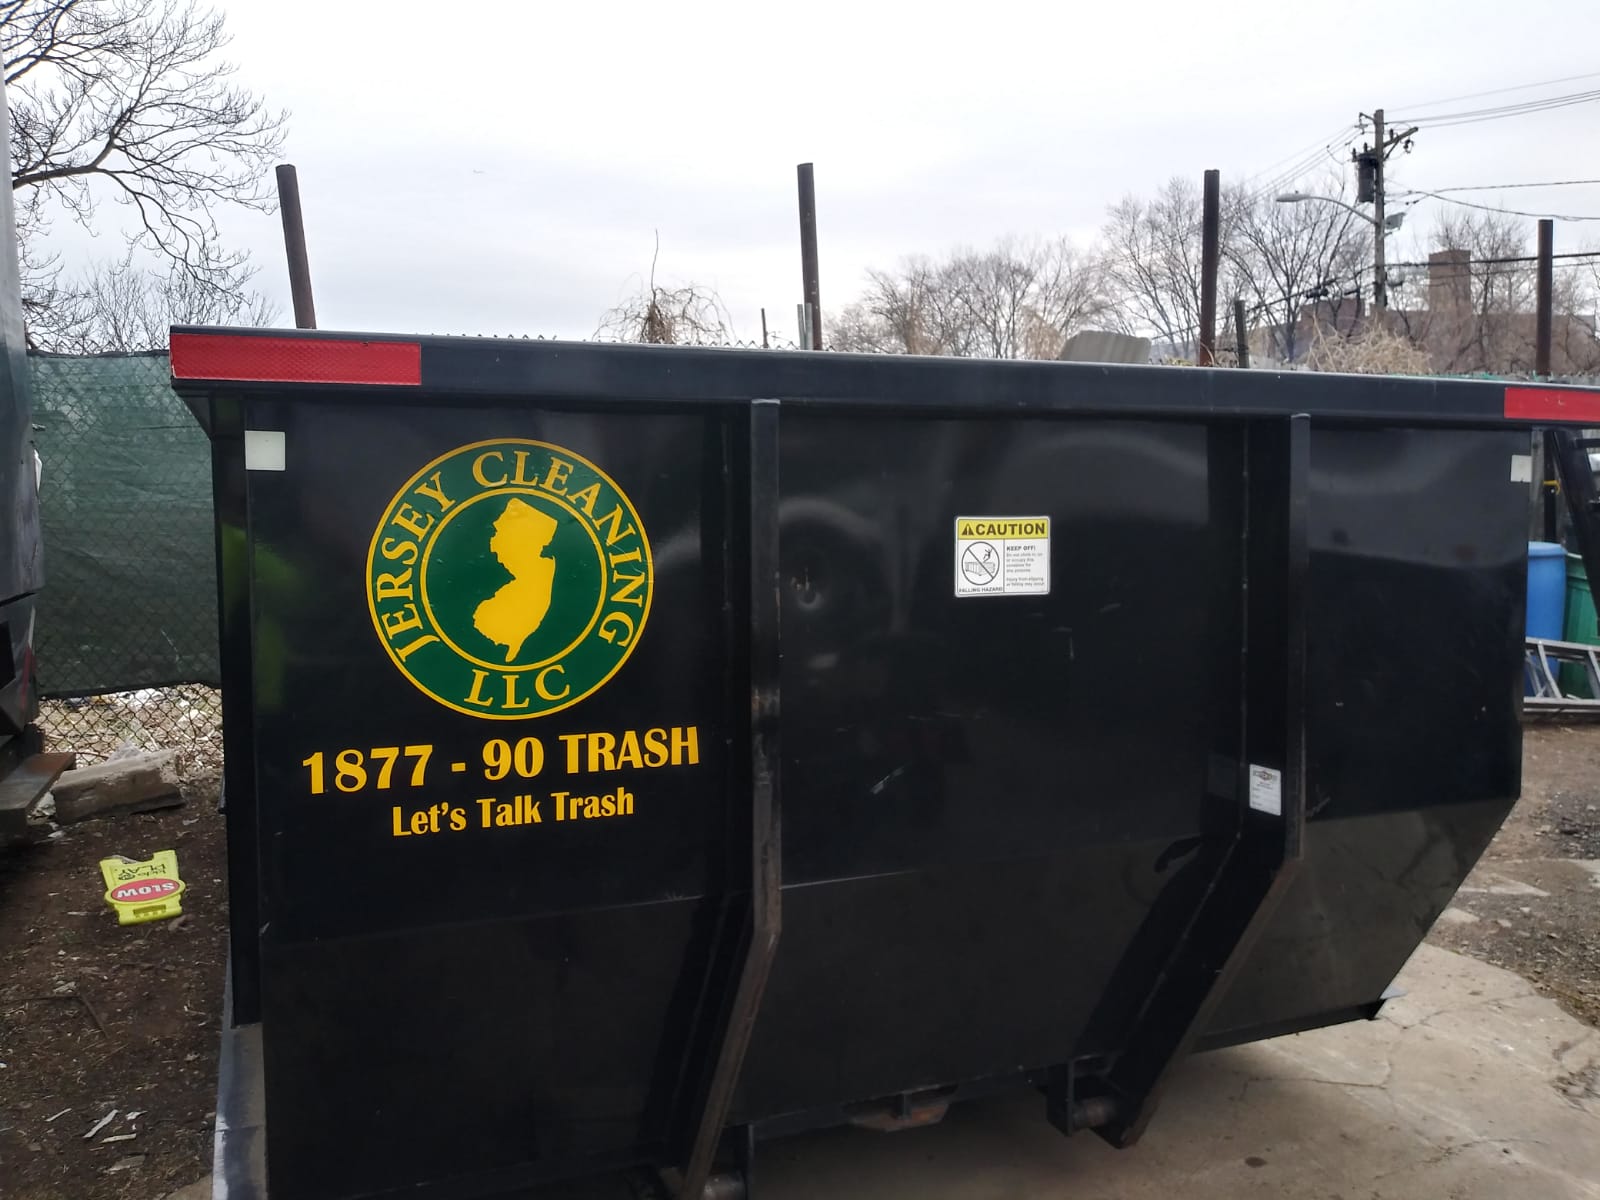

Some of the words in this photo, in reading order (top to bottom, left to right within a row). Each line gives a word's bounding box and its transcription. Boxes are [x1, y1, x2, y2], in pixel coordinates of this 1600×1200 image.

[976, 522, 1045, 536] CAUTION
[376, 471, 456, 663] JERSEY
[471, 449, 646, 649] CLEANING
[463, 664, 571, 709] LLC
[302, 744, 433, 794] 1877
[481, 736, 544, 781] 90
[558, 726, 700, 774] TRASH
[392, 802, 467, 837] Let's
[476, 794, 543, 829] Talk
[550, 786, 635, 822] Trash
[117, 882, 175, 899] SLOW
